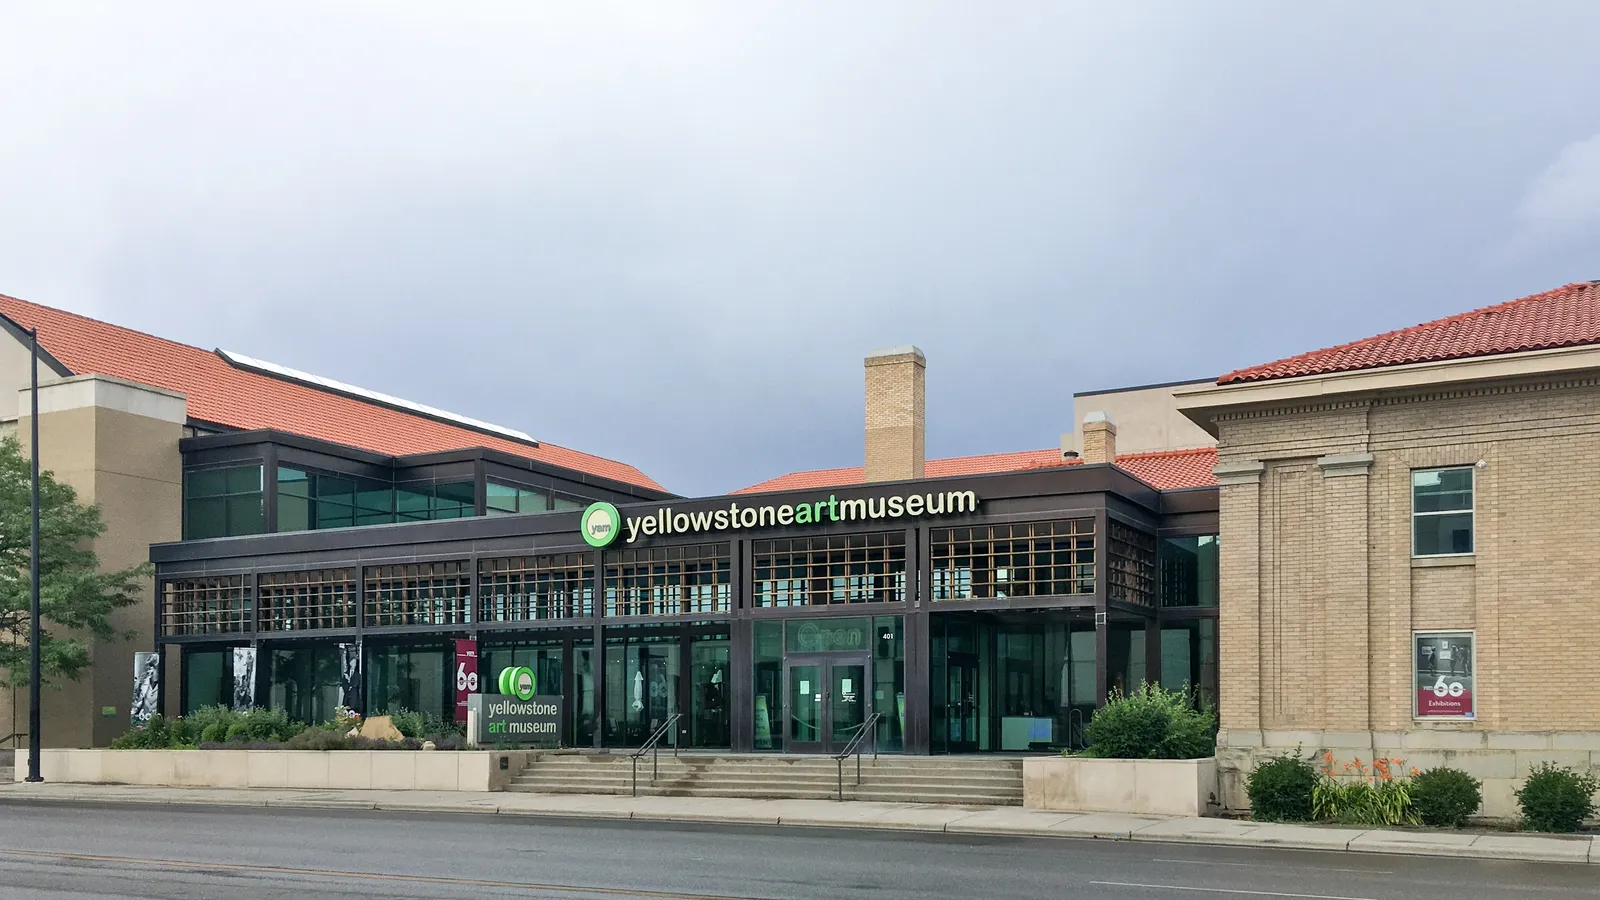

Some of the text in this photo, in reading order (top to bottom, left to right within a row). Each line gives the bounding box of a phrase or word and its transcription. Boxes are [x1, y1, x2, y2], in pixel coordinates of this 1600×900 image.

[591, 524, 611, 535] yam
[457, 662, 477, 691] 60
[1434, 675, 1463, 697] 60
[488, 700, 557, 718] yellowstone
[488, 719, 557, 733] art museum
